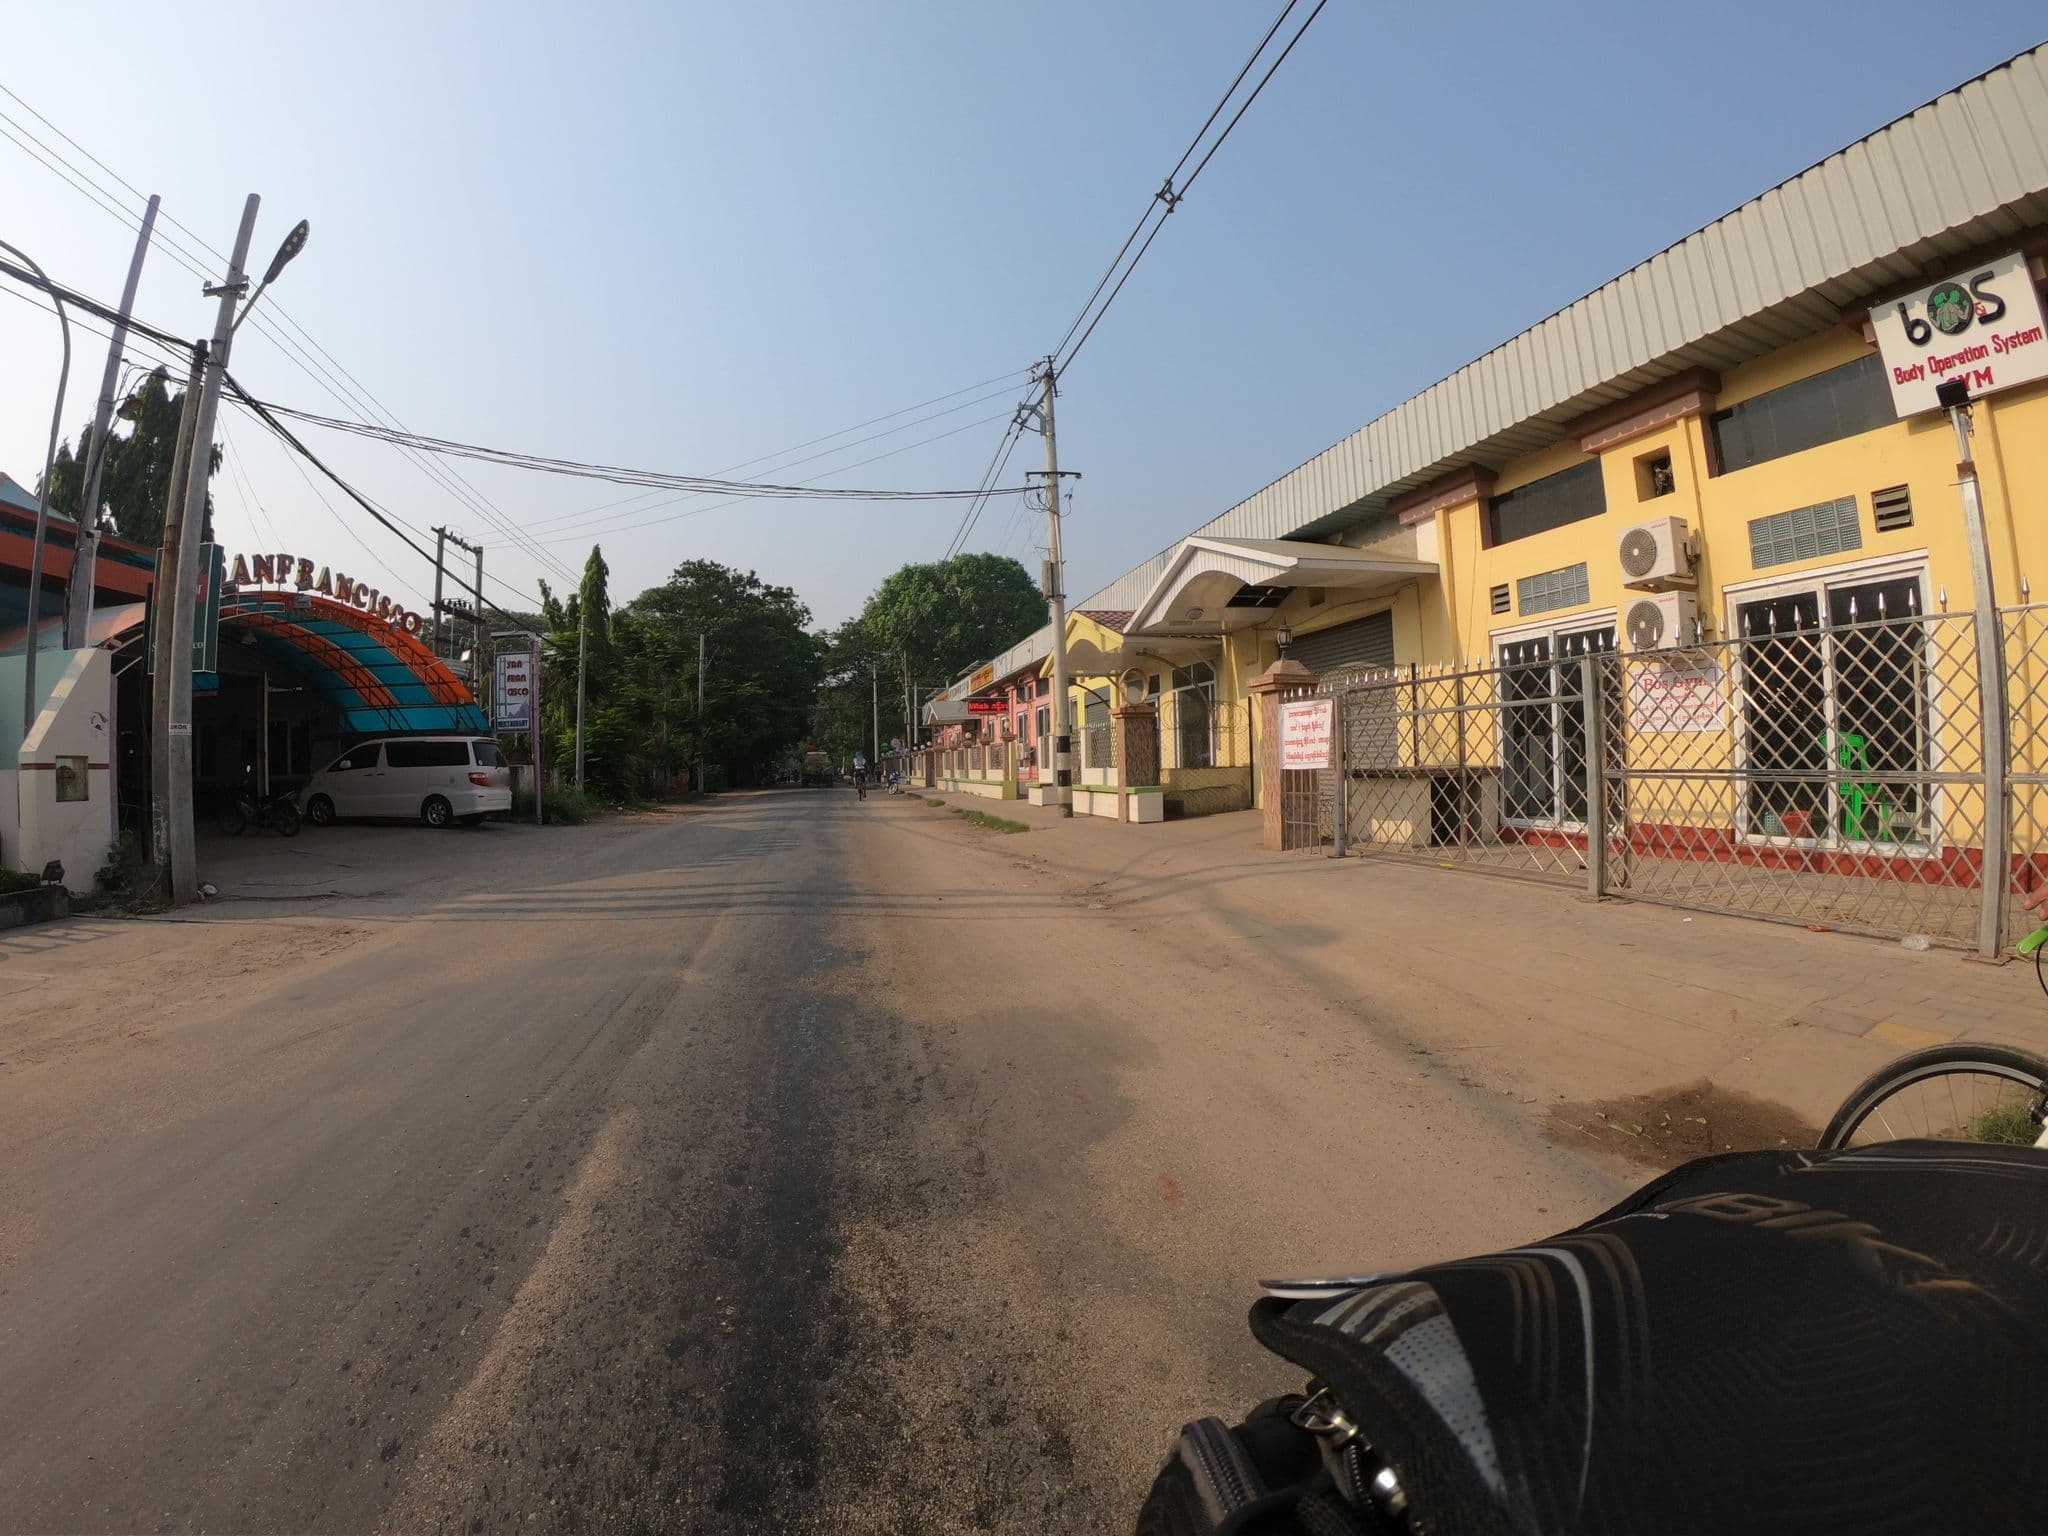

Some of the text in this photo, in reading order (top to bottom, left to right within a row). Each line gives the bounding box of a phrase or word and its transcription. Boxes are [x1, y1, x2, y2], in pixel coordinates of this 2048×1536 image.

[1893, 326, 2043, 385] Body Operation System
[1946, 366, 1995, 391] YM
